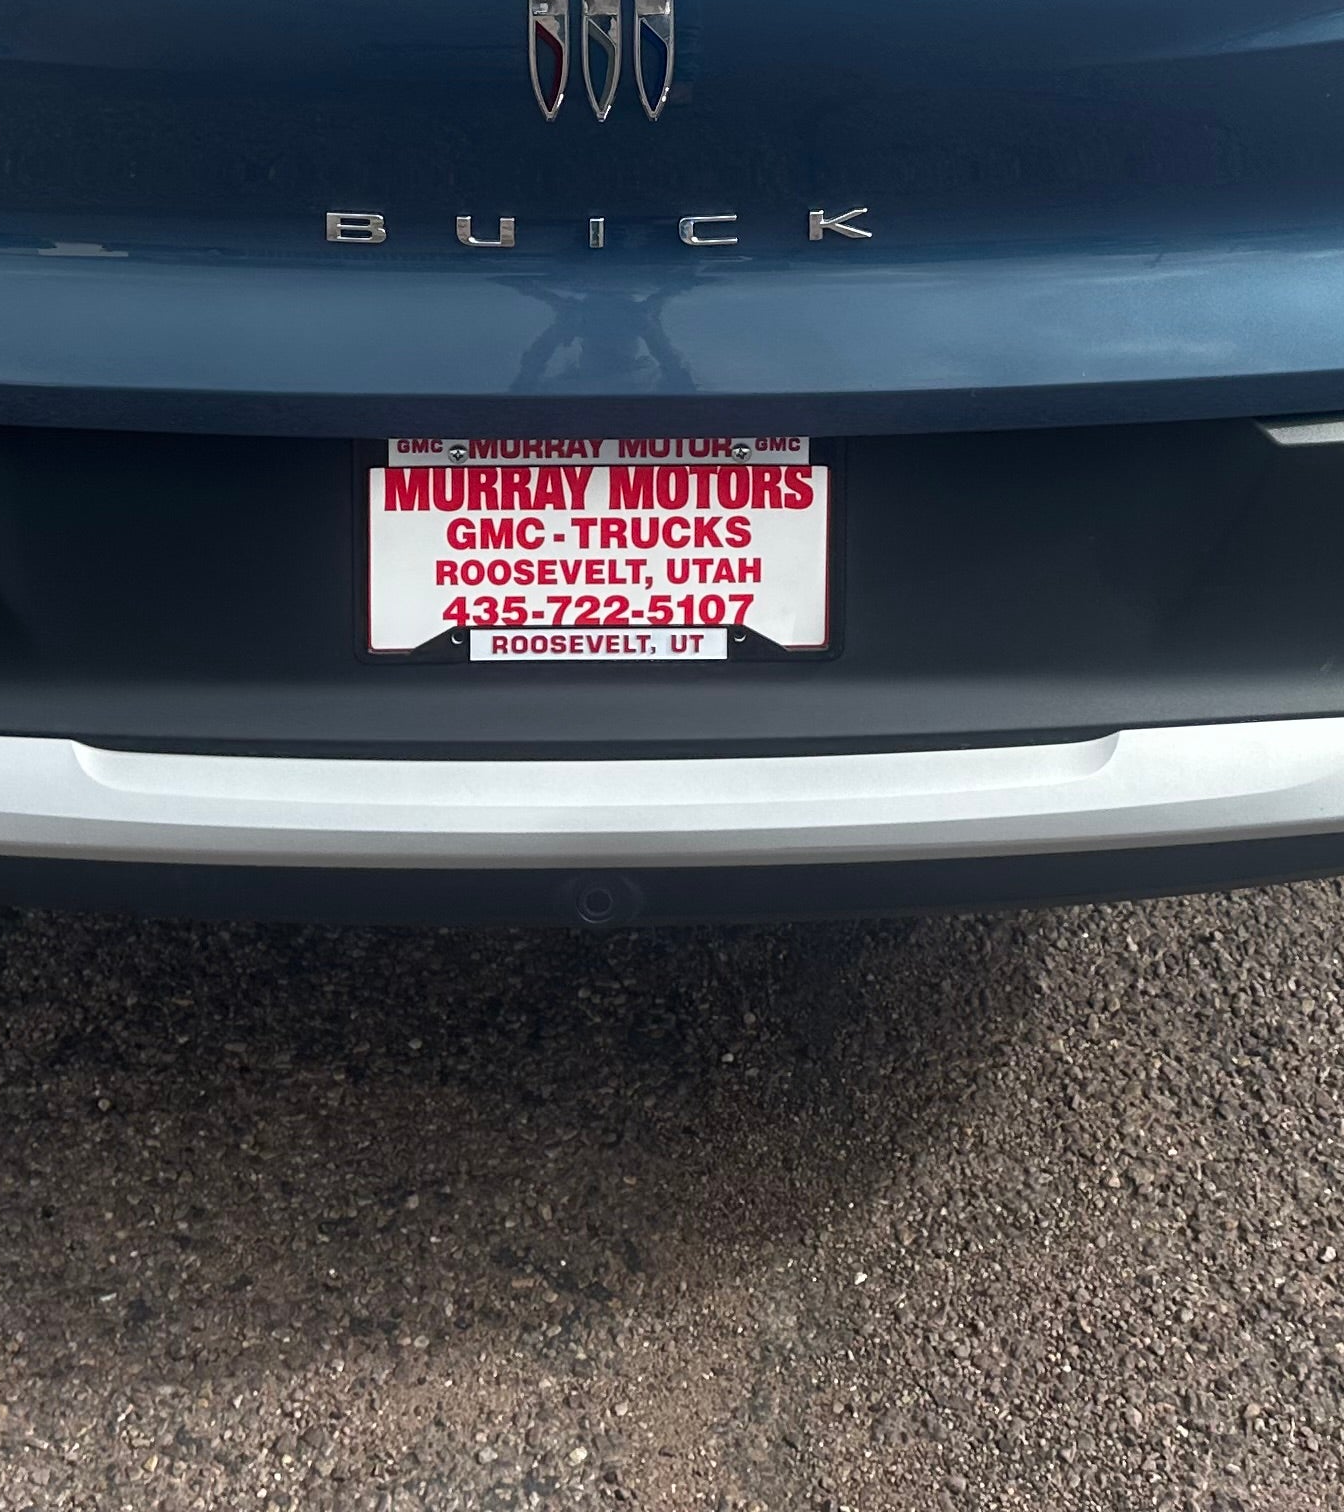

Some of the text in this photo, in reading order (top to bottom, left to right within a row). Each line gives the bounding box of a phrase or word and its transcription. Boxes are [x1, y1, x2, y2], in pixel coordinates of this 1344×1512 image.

[326, 207, 872, 248] BUICK
[396, 438, 444, 454] GMC
[468, 438, 604, 459] MURRAY
[754, 437, 801, 452] GMC
[383, 465, 814, 512] MURRAY MOTORS
[436, 558, 762, 590] ROOSEVELT, UTAH
[442, 594, 755, 626] 435-722-5107
[492, 634, 704, 655] ROOSEVELT, UT
